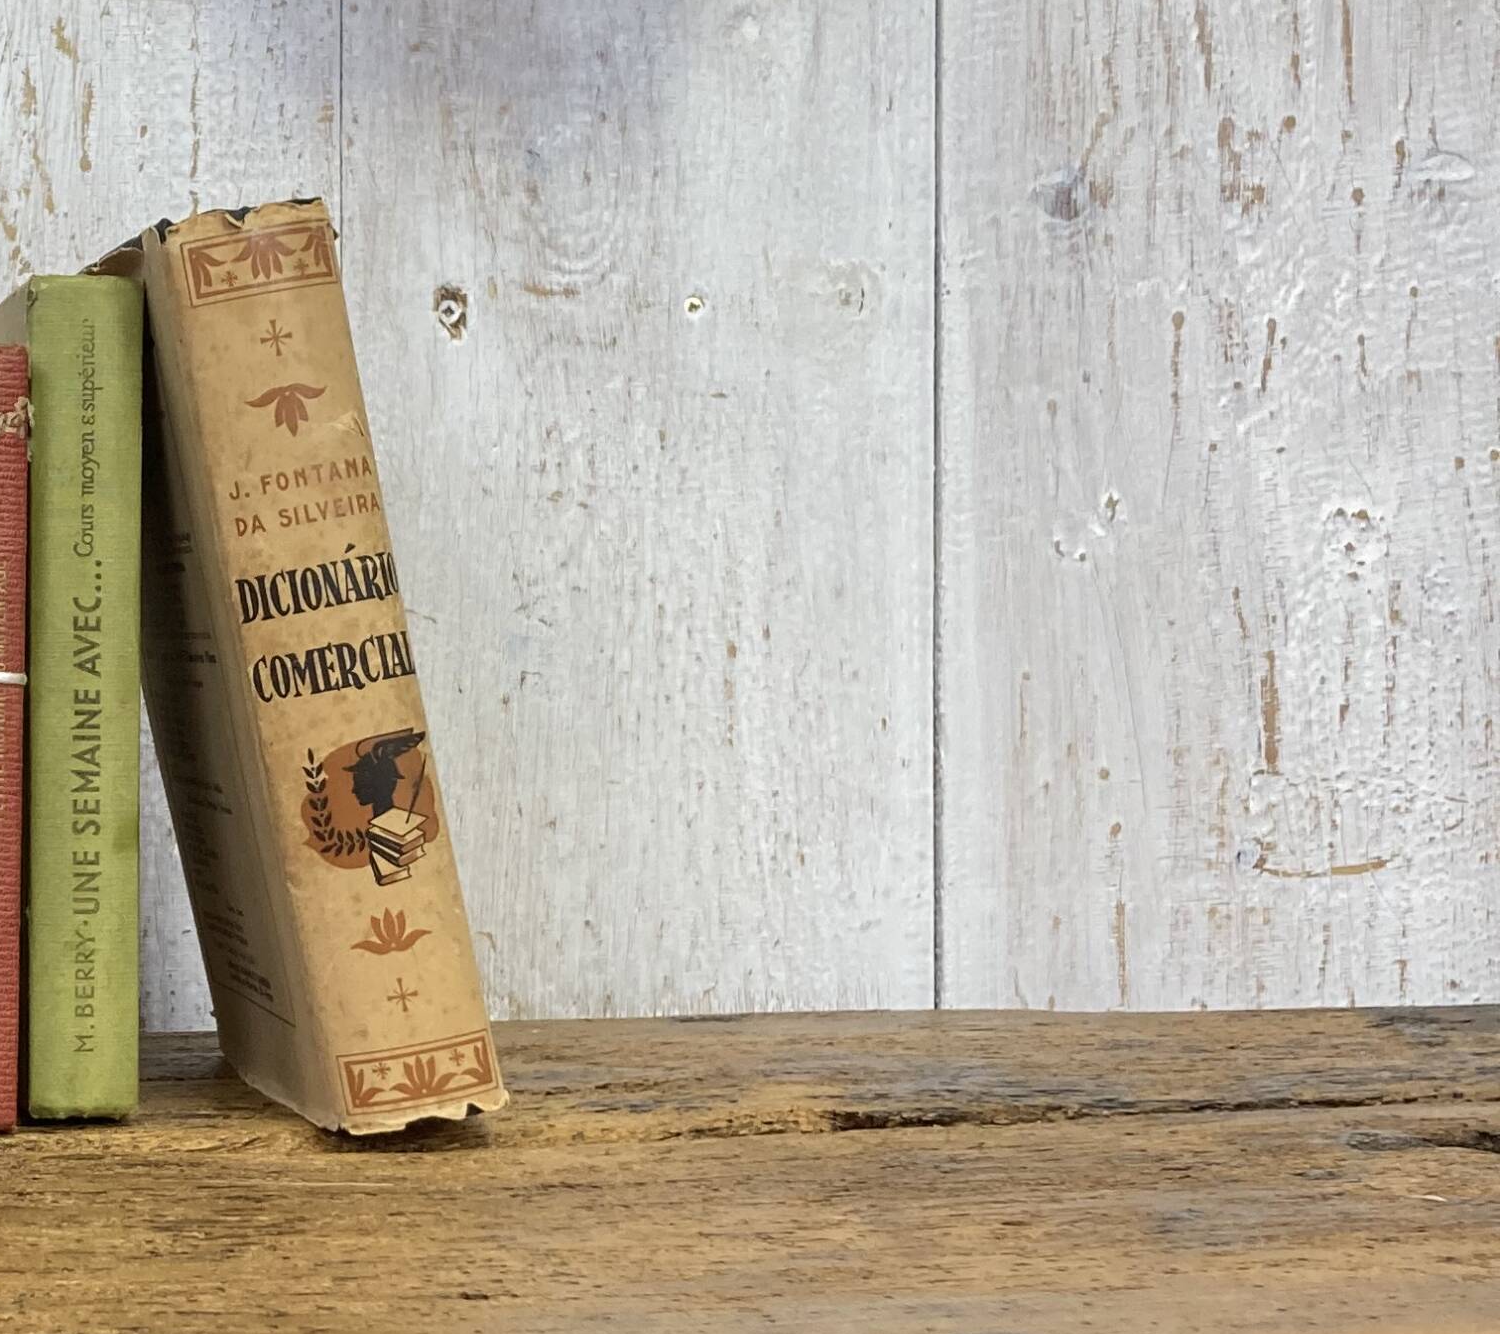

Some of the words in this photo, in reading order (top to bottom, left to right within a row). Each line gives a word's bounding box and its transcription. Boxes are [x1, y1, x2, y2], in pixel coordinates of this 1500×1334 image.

[80, 431, 101, 497] moyen
[229, 480, 250, 501] J.
[260, 455, 374, 495] FONTANA
[72, 504, 95, 558] Cours
[234, 514, 267, 537] DA
[278, 492, 381, 528] SILVEIRA
[234, 542, 399, 624] DICIONÁRIO
[71, 688, 102, 837] SEMAINE
[71, 850, 102, 916] UNE
[74, 931, 96, 1018] BERRY
[74, 1024, 96, 1053] M.
